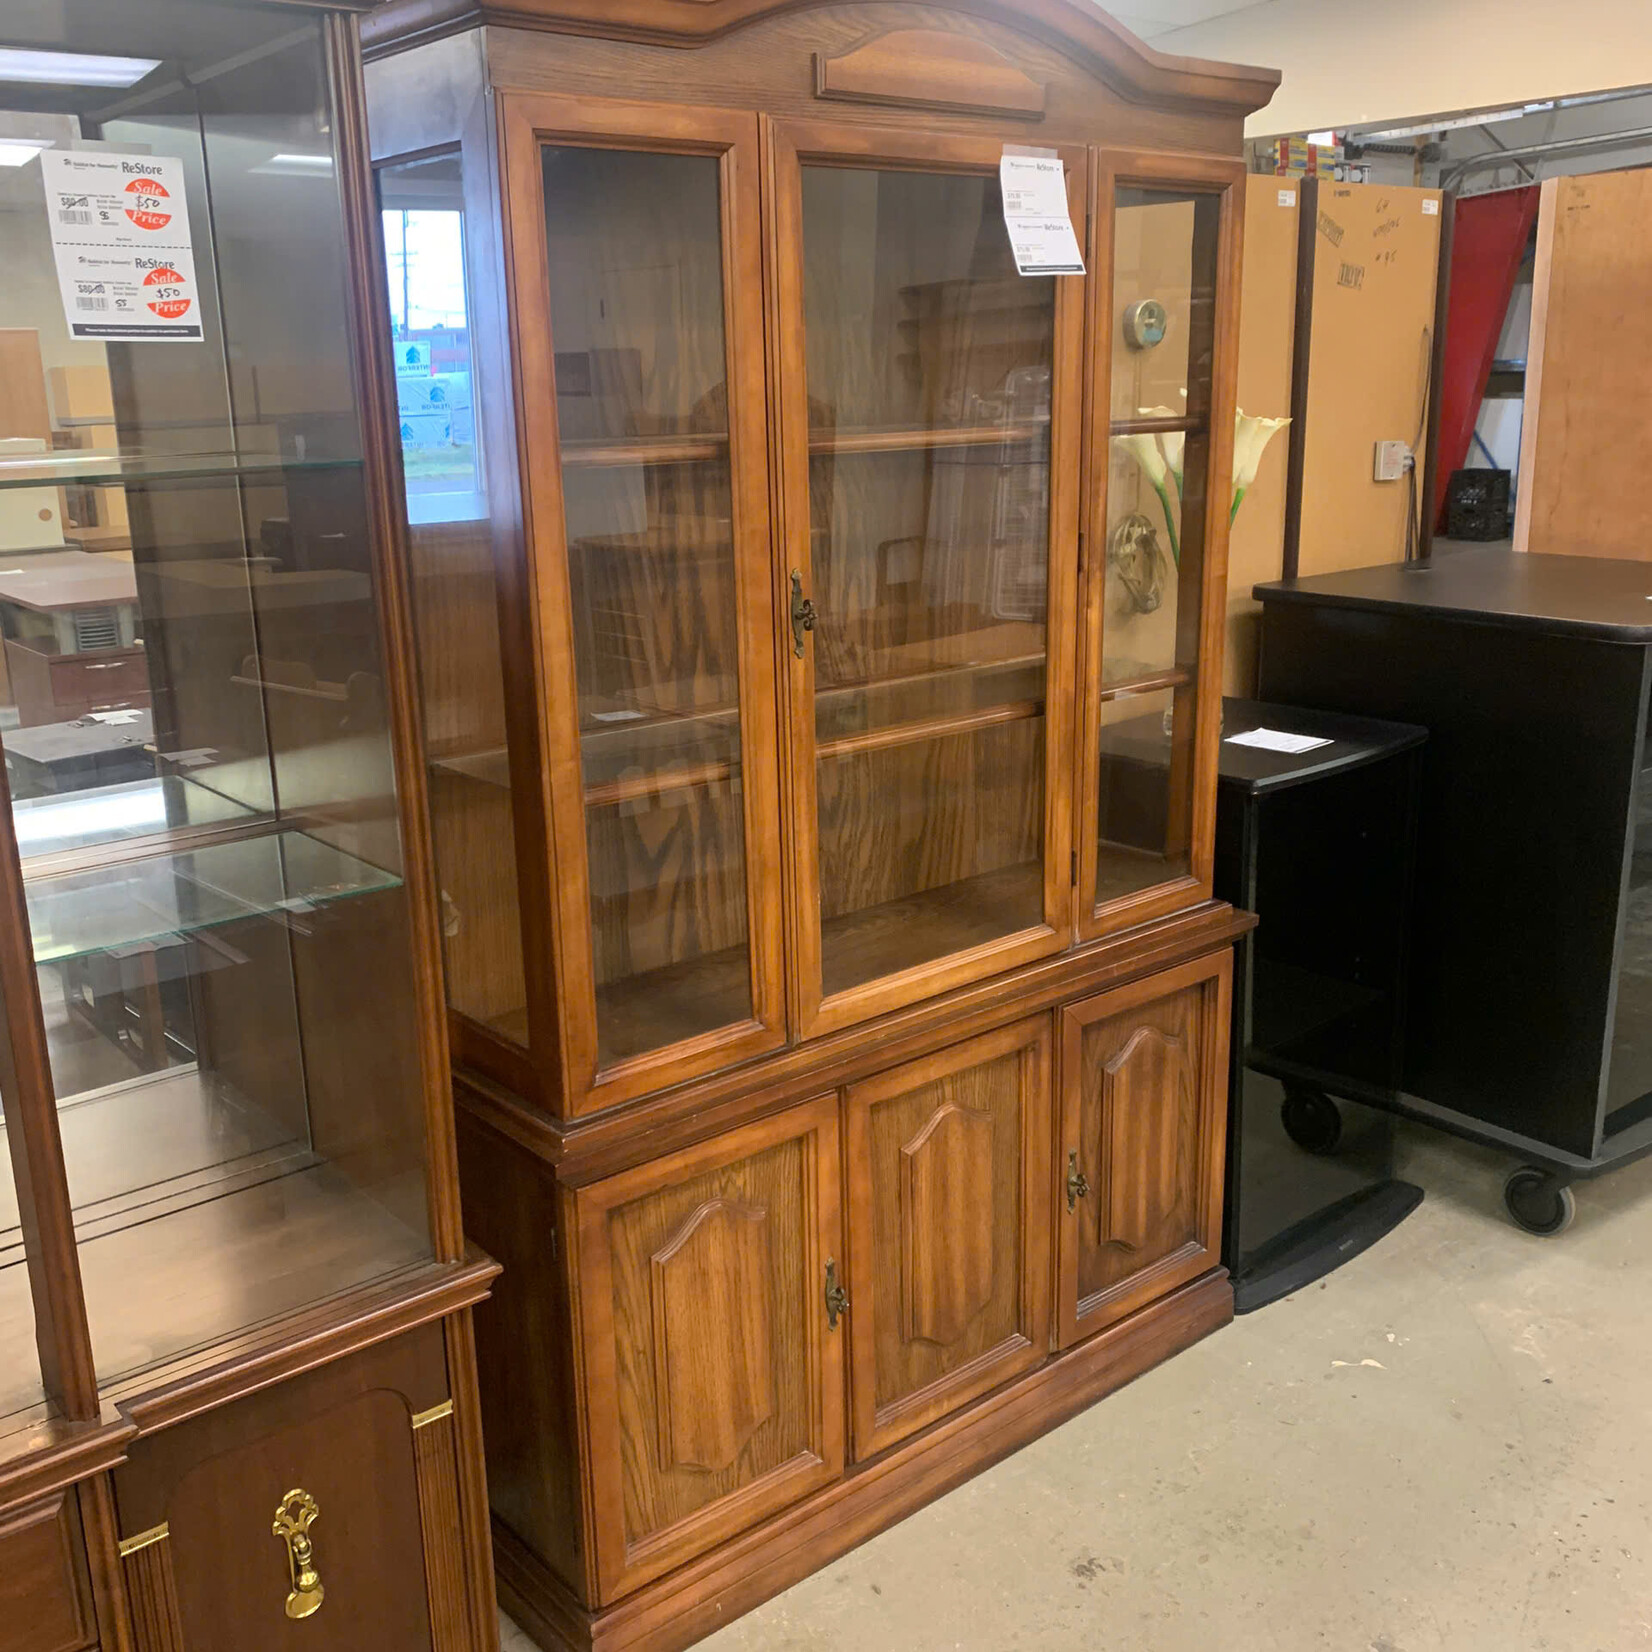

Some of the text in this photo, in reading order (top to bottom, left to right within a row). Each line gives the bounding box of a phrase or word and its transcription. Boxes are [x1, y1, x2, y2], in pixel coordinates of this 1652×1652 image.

[122, 162, 163, 176] ReStore
[133, 182, 163, 196] Sale
[137, 195, 160, 211] $50
[131, 211, 167, 226] Price
[135, 258, 175, 270] ReStore
[151, 273, 178, 285] Sale
[156, 288, 180, 299] $50
[155, 302, 187, 314] Price
